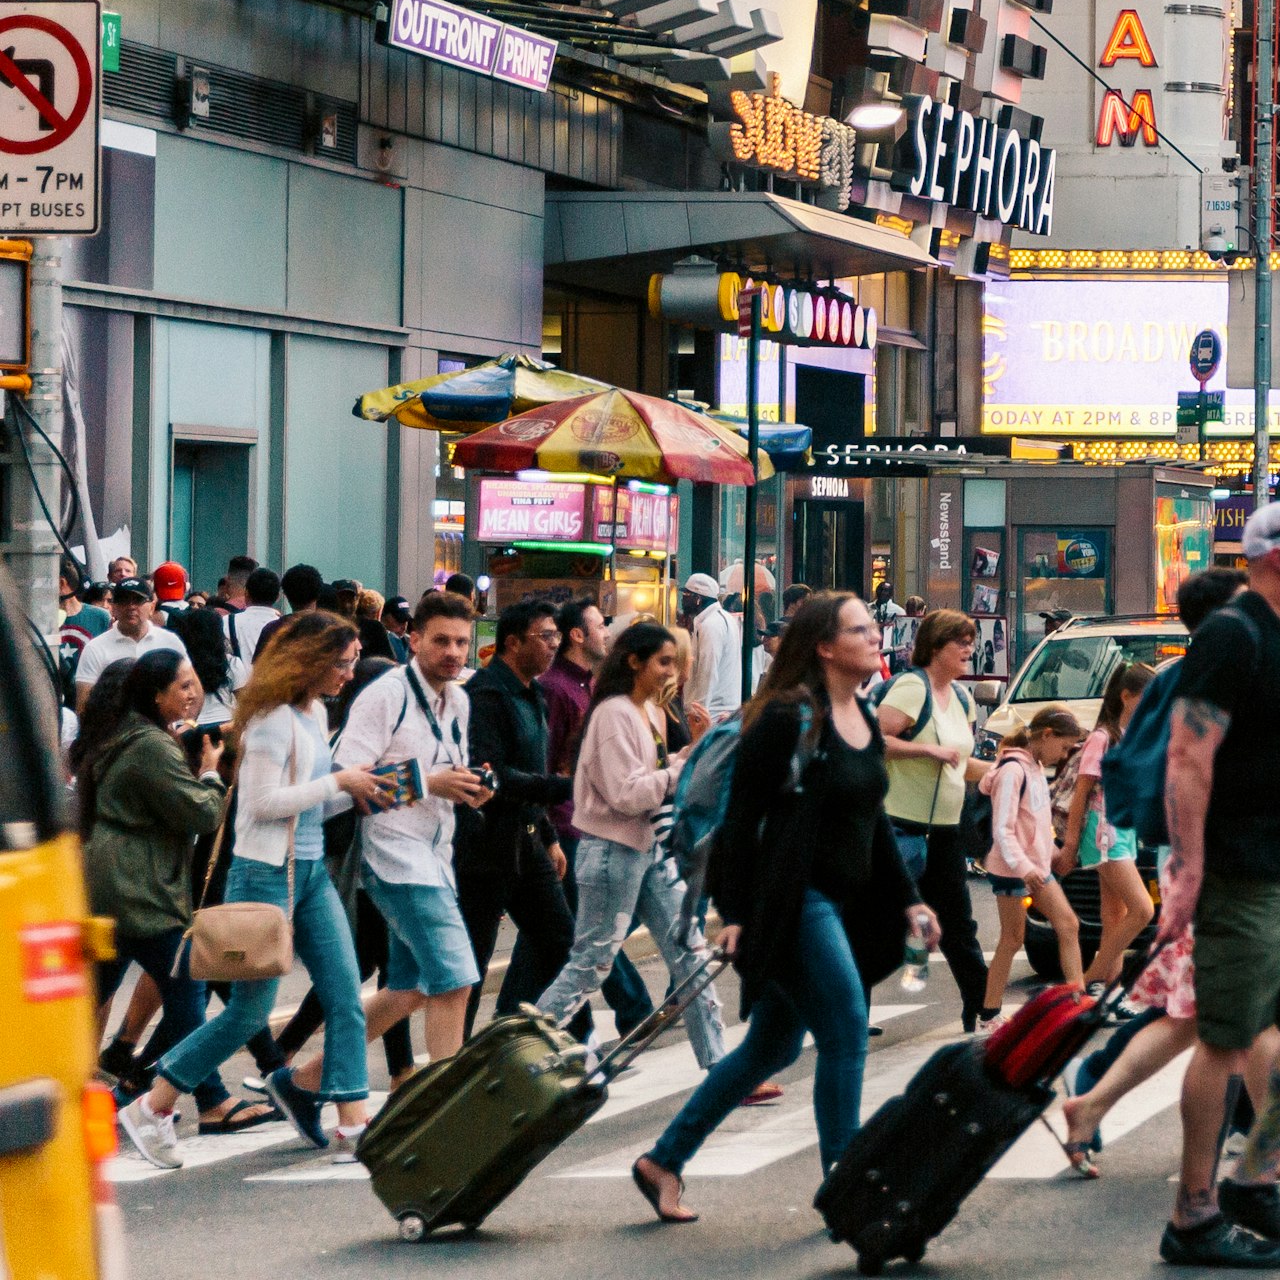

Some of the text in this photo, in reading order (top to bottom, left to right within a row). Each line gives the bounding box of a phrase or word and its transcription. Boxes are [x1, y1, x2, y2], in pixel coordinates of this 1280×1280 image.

[502, 34, 550, 83] PRIME
[910, 95, 1057, 237] SEPHORA
[36, 166, 83, 193] 7PM
[30, 203, 85, 216] BUSES
[1206, 392, 1222, 404] M42
[1052, 410, 1074, 426] AT
[1083, 410, 1121, 426] 2PM
[1130, 410, 1142, 426] &
[1206, 409, 1221, 420] MTA
[811, 476, 849, 497] SEPHORA
[483, 509, 529, 532] MEAN
[535, 511, 582, 534] GIRLS
[940, 492, 952, 569] Newsstand
